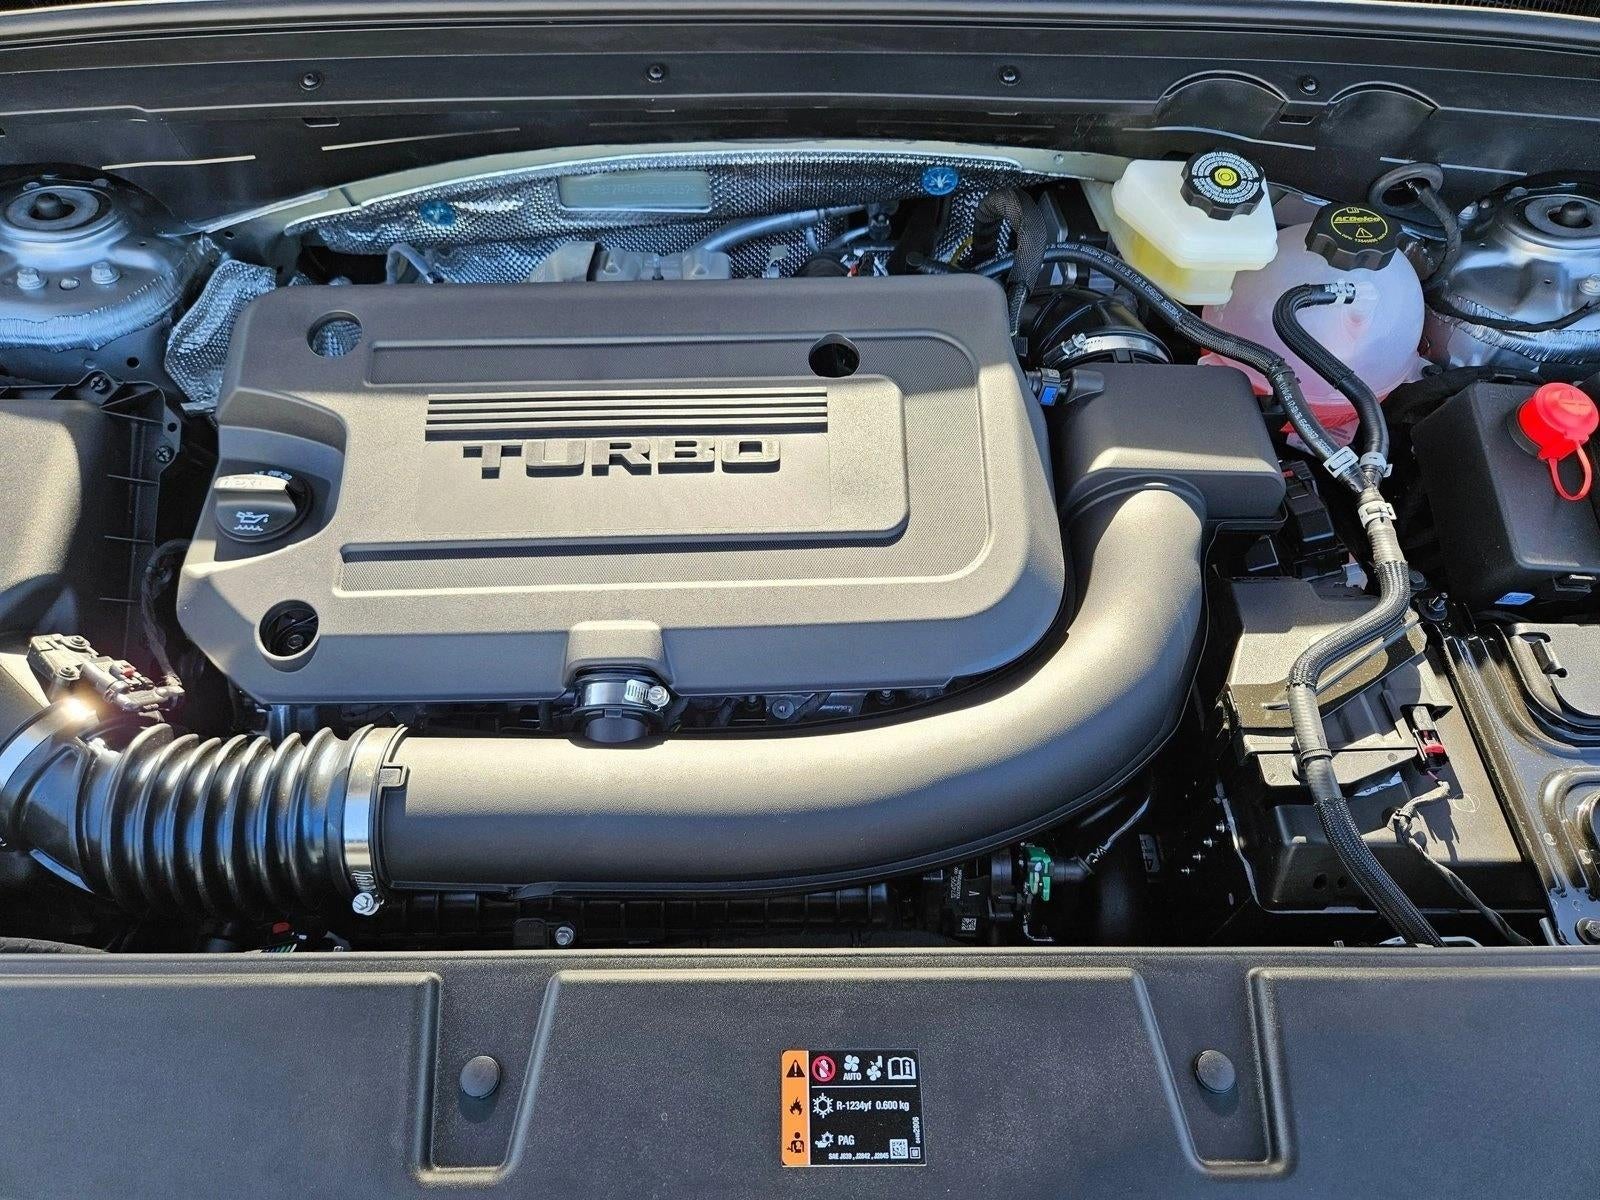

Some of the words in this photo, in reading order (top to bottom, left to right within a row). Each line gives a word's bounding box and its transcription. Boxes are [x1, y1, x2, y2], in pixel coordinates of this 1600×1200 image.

[1334, 215, 1381, 223] ACDelco
[463, 438, 781, 479] TURBO
[843, 1072, 862, 1081] AUTO
[836, 1100, 872, 1112] R-1234yf
[875, 1100, 898, 1110] 0.600
[899, 1100, 910, 1112] kg
[837, 1135, 855, 1146] PAG
